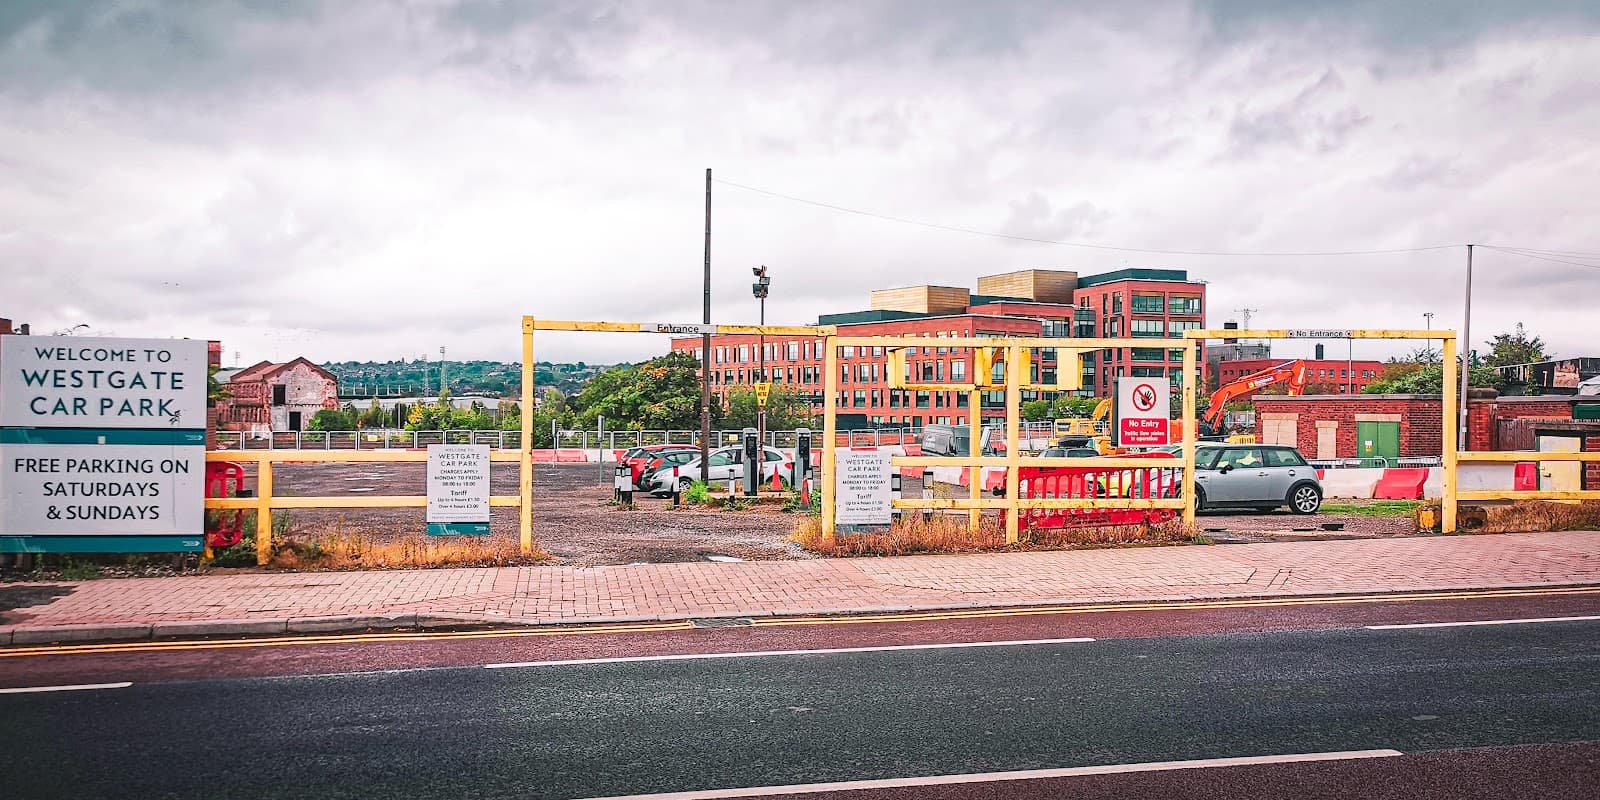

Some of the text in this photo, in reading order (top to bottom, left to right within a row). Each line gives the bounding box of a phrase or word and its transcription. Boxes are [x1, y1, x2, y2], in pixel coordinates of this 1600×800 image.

[657, 324, 699, 333] Entrance
[34, 347, 172, 362] WELCOME TO
[21, 369, 184, 390] WESTGATE
[30, 396, 176, 416] CAR PARK
[1142, 420, 1160, 428] Entry
[15, 458, 189, 474] FREE PARKING ON
[43, 482, 160, 496] SATURDAYS
[46, 505, 160, 520] & SUNDAYS
